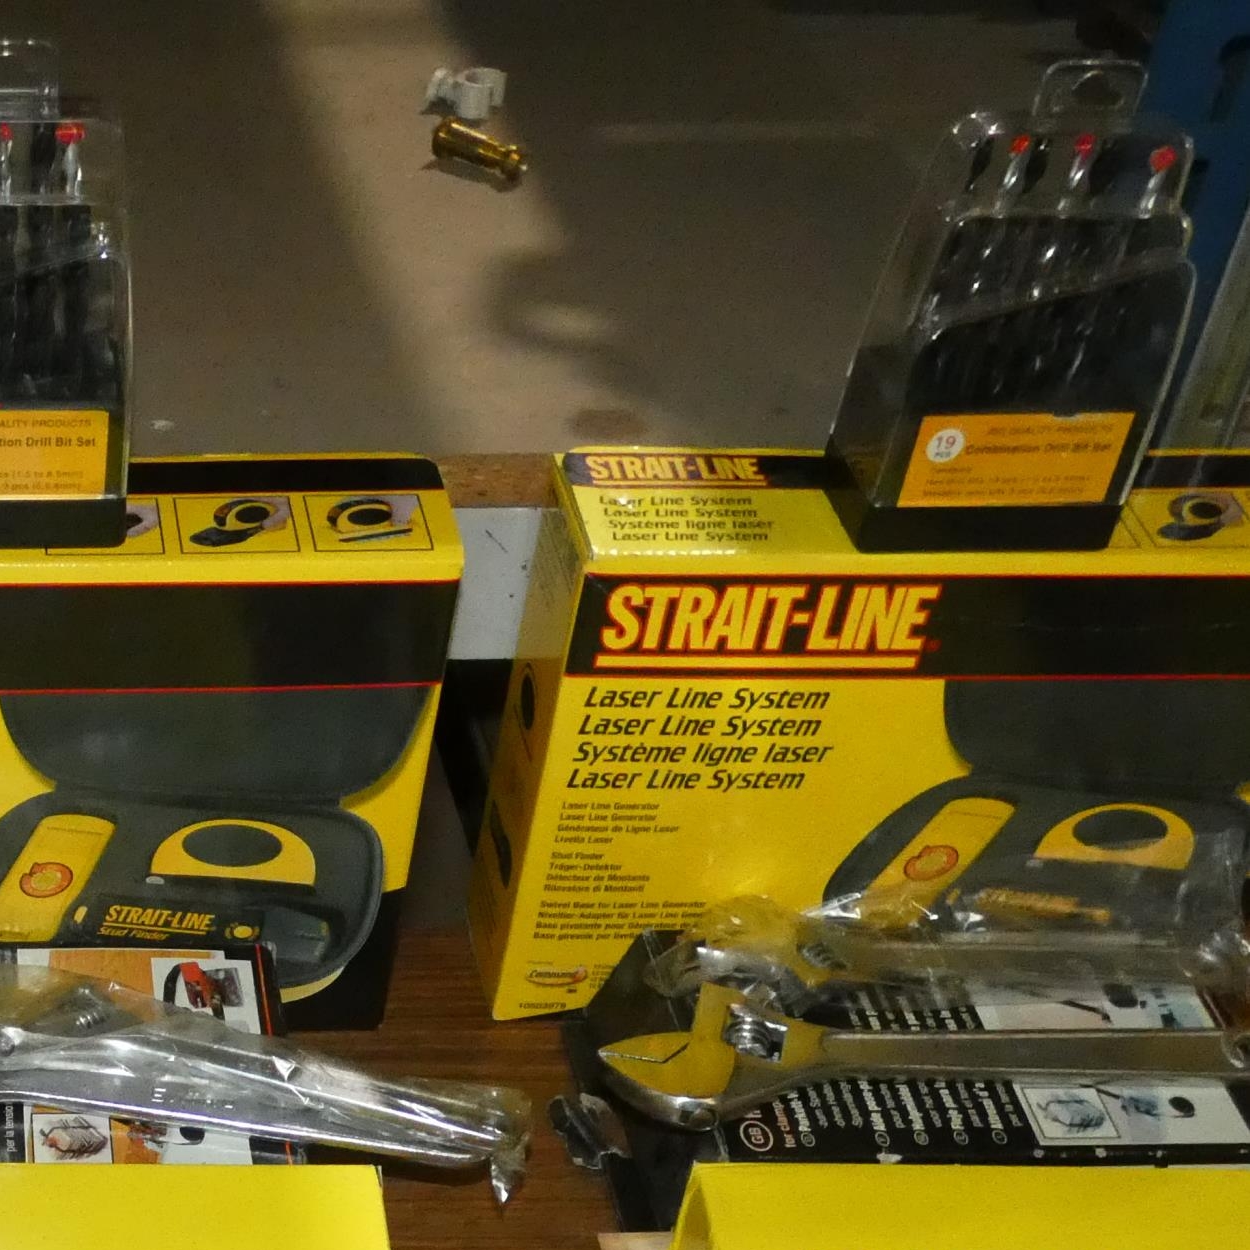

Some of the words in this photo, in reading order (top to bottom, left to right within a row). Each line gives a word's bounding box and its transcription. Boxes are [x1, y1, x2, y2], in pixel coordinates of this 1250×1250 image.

[25, 437, 51, 448] Drill
[55, 437, 72, 448] Bit
[76, 437, 96, 448] Set
[935, 435, 957, 449] 19
[585, 456, 765, 482] STRAIT-LINE
[650, 496, 684, 506] Line
[690, 496, 752, 508] System
[604, 508, 648, 518] Laser
[655, 508, 689, 518] Line
[695, 508, 757, 520] System
[608, 520, 683, 531] Système
[686, 520, 726, 531] ligne
[732, 520, 775, 530] laser
[612, 532, 659, 541] Laser
[665, 532, 699, 541] Line
[705, 532, 769, 543] System
[599, 583, 943, 653] STRAIT-LINE
[584, 686, 662, 709] Laser
[666, 686, 723, 709] Line
[729, 687, 831, 713] System
[577, 714, 655, 737] Laser
[660, 714, 715, 737] Line
[721, 716, 822, 741] System
[572, 742, 685, 767] Système
[692, 742, 759, 767] ligne
[763, 742, 834, 763] laser
[566, 768, 644, 790] Laser
[646, 768, 701, 790] Line
[707, 769, 806, 793] System
[105, 904, 215, 930] STRAIT-LINE
[97, 926, 129, 937] Stud
[130, 929, 171, 942] Finder
[869, 1112, 887, 1131] Aide
[5, 1130, 15, 1138] la
[748, 1127, 765, 1144] GB
[783, 1132, 797, 1148] for
[6, 1139, 17, 1152] per
